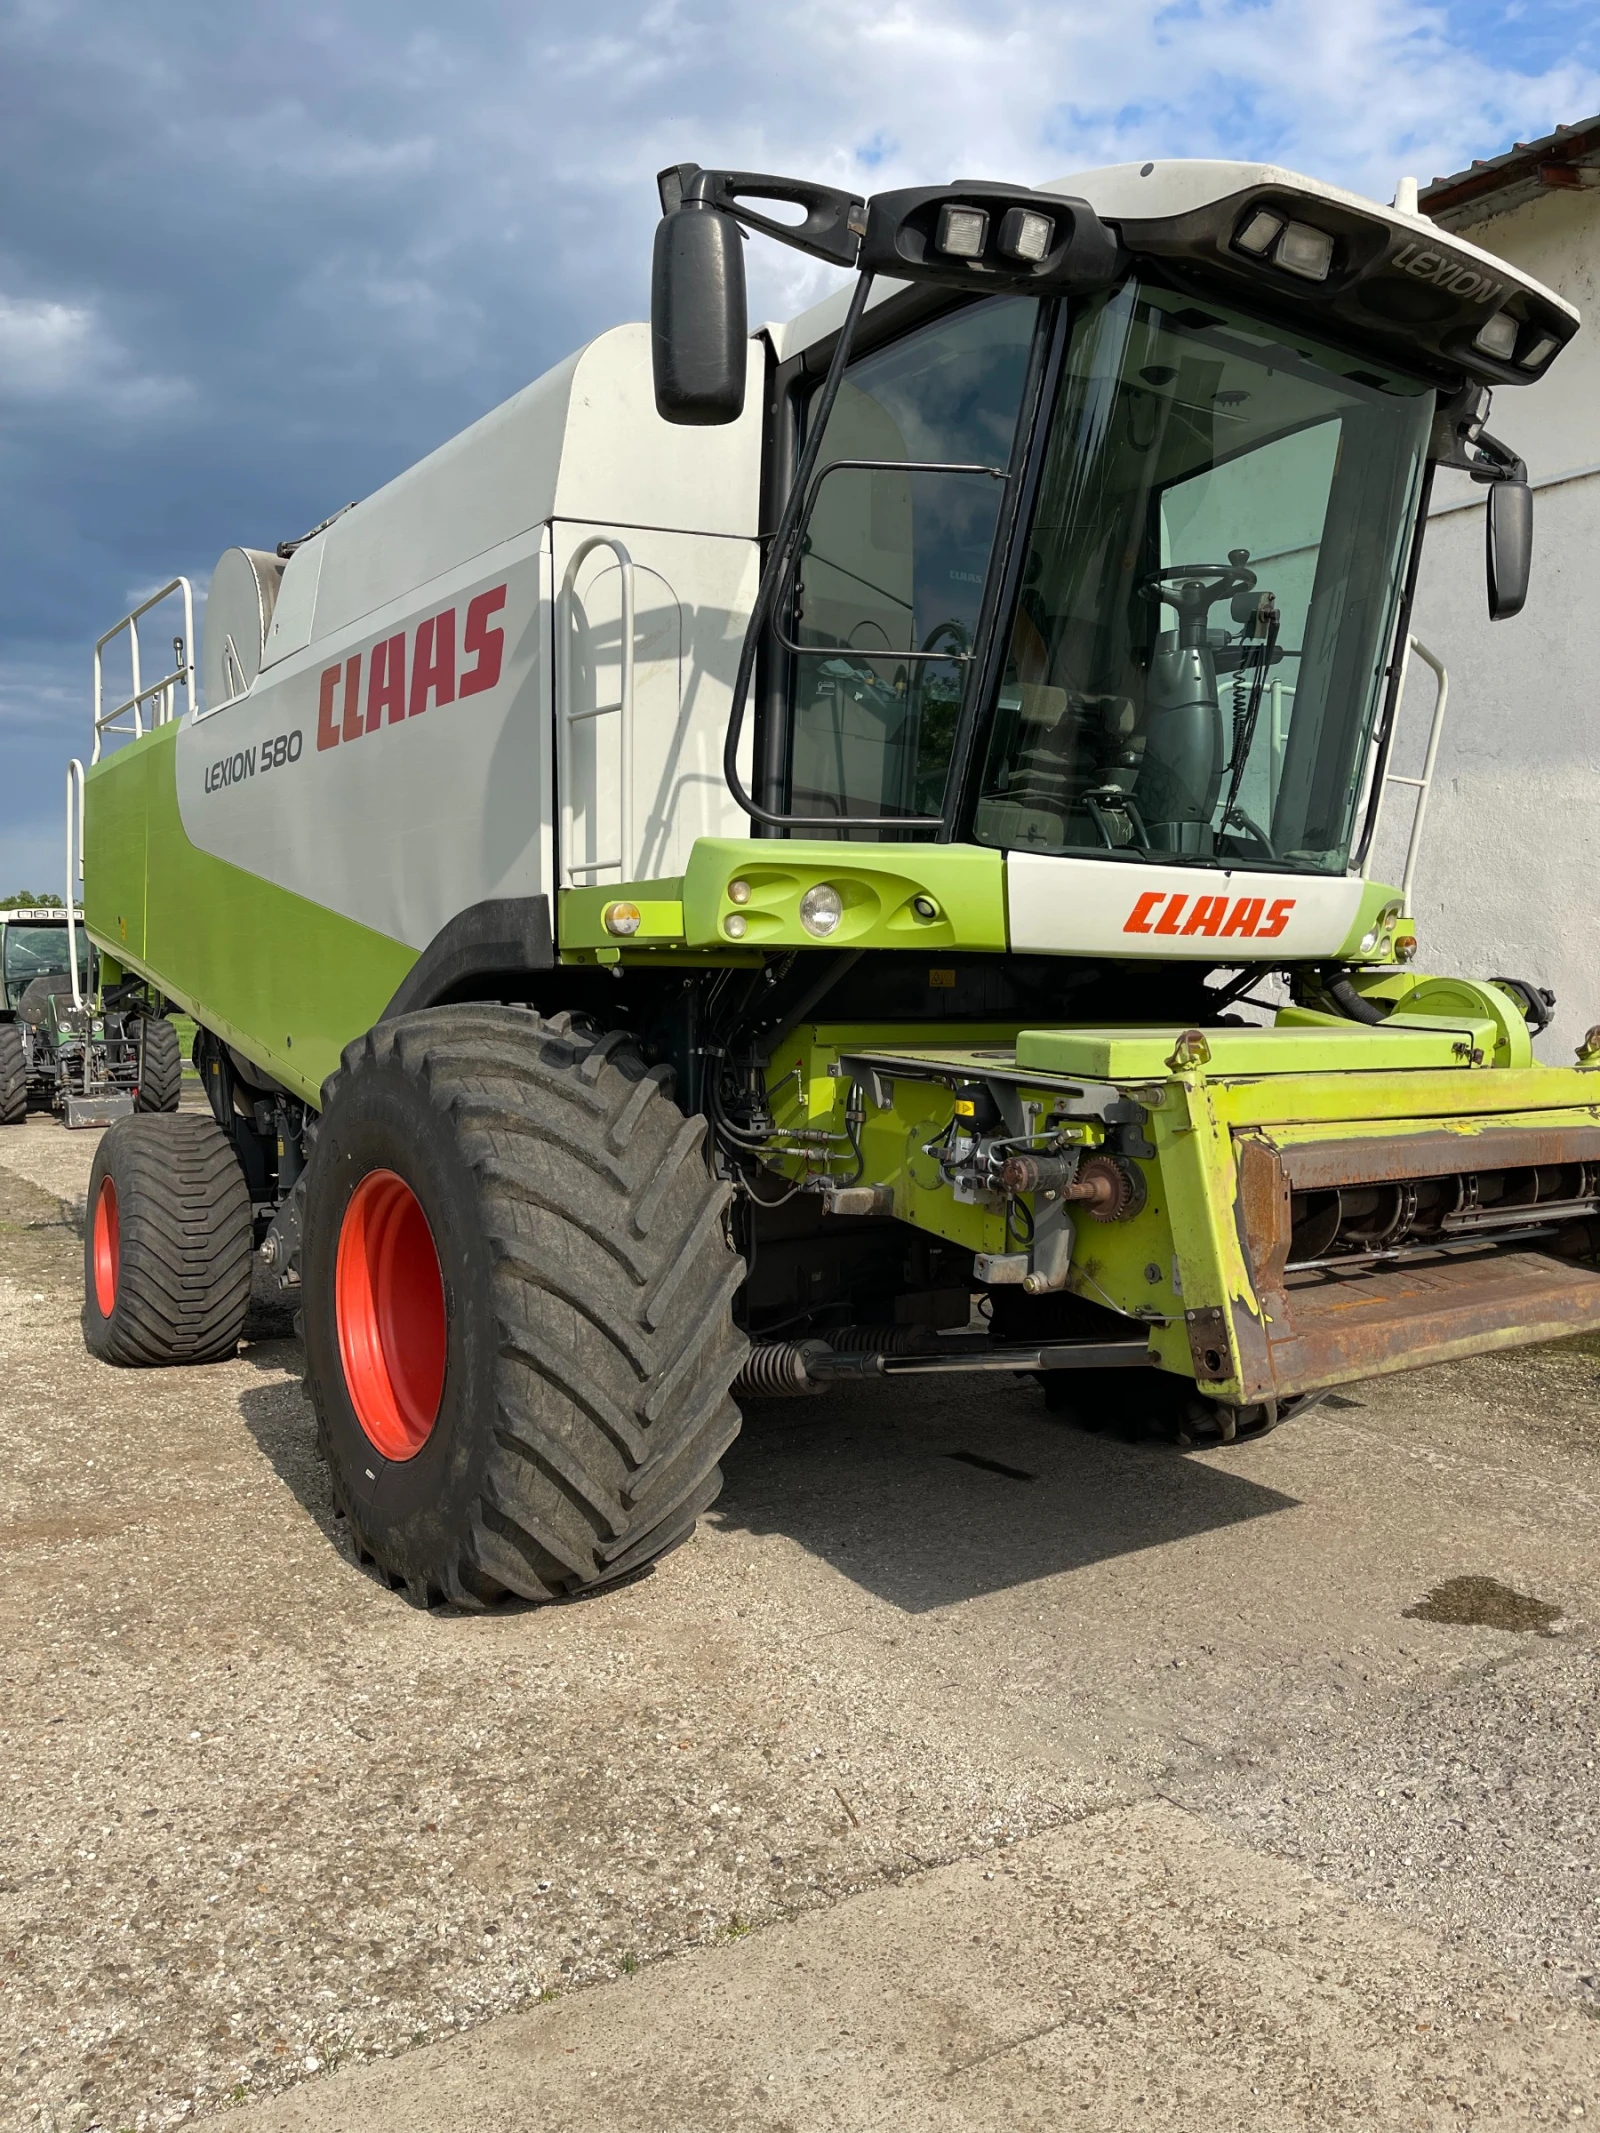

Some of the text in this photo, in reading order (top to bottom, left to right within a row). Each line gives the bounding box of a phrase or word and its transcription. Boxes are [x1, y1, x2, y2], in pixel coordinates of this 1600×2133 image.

[1391, 242, 1502, 304] LEXION
[317, 583, 507, 752] CLAAS
[204, 729, 303, 794] LEXION 580
[1123, 891, 1297, 938] CLAAS
